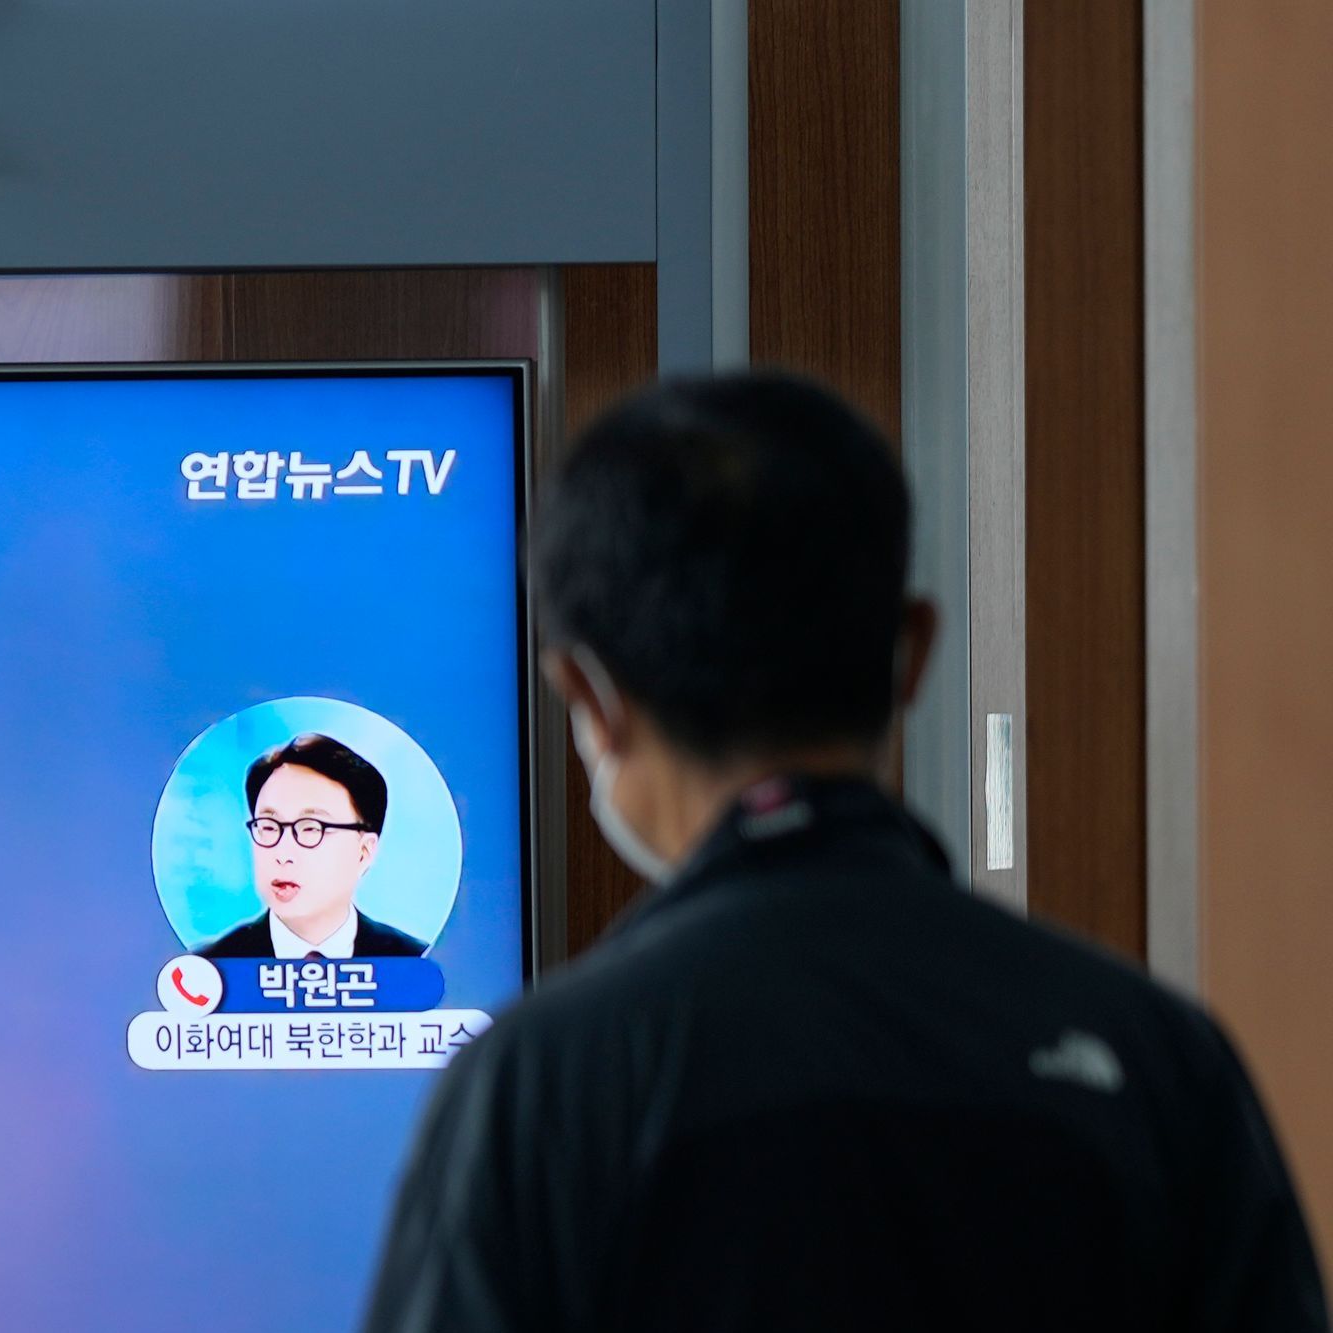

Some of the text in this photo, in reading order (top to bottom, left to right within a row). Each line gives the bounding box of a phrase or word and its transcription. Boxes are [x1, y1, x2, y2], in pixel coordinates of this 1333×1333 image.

[180, 450, 456, 500] 연합뉴스TV
[259, 963, 377, 1008] 박원곤
[156, 1023, 274, 1060] 이화여대
[285, 1023, 407, 1059] 북한학과
